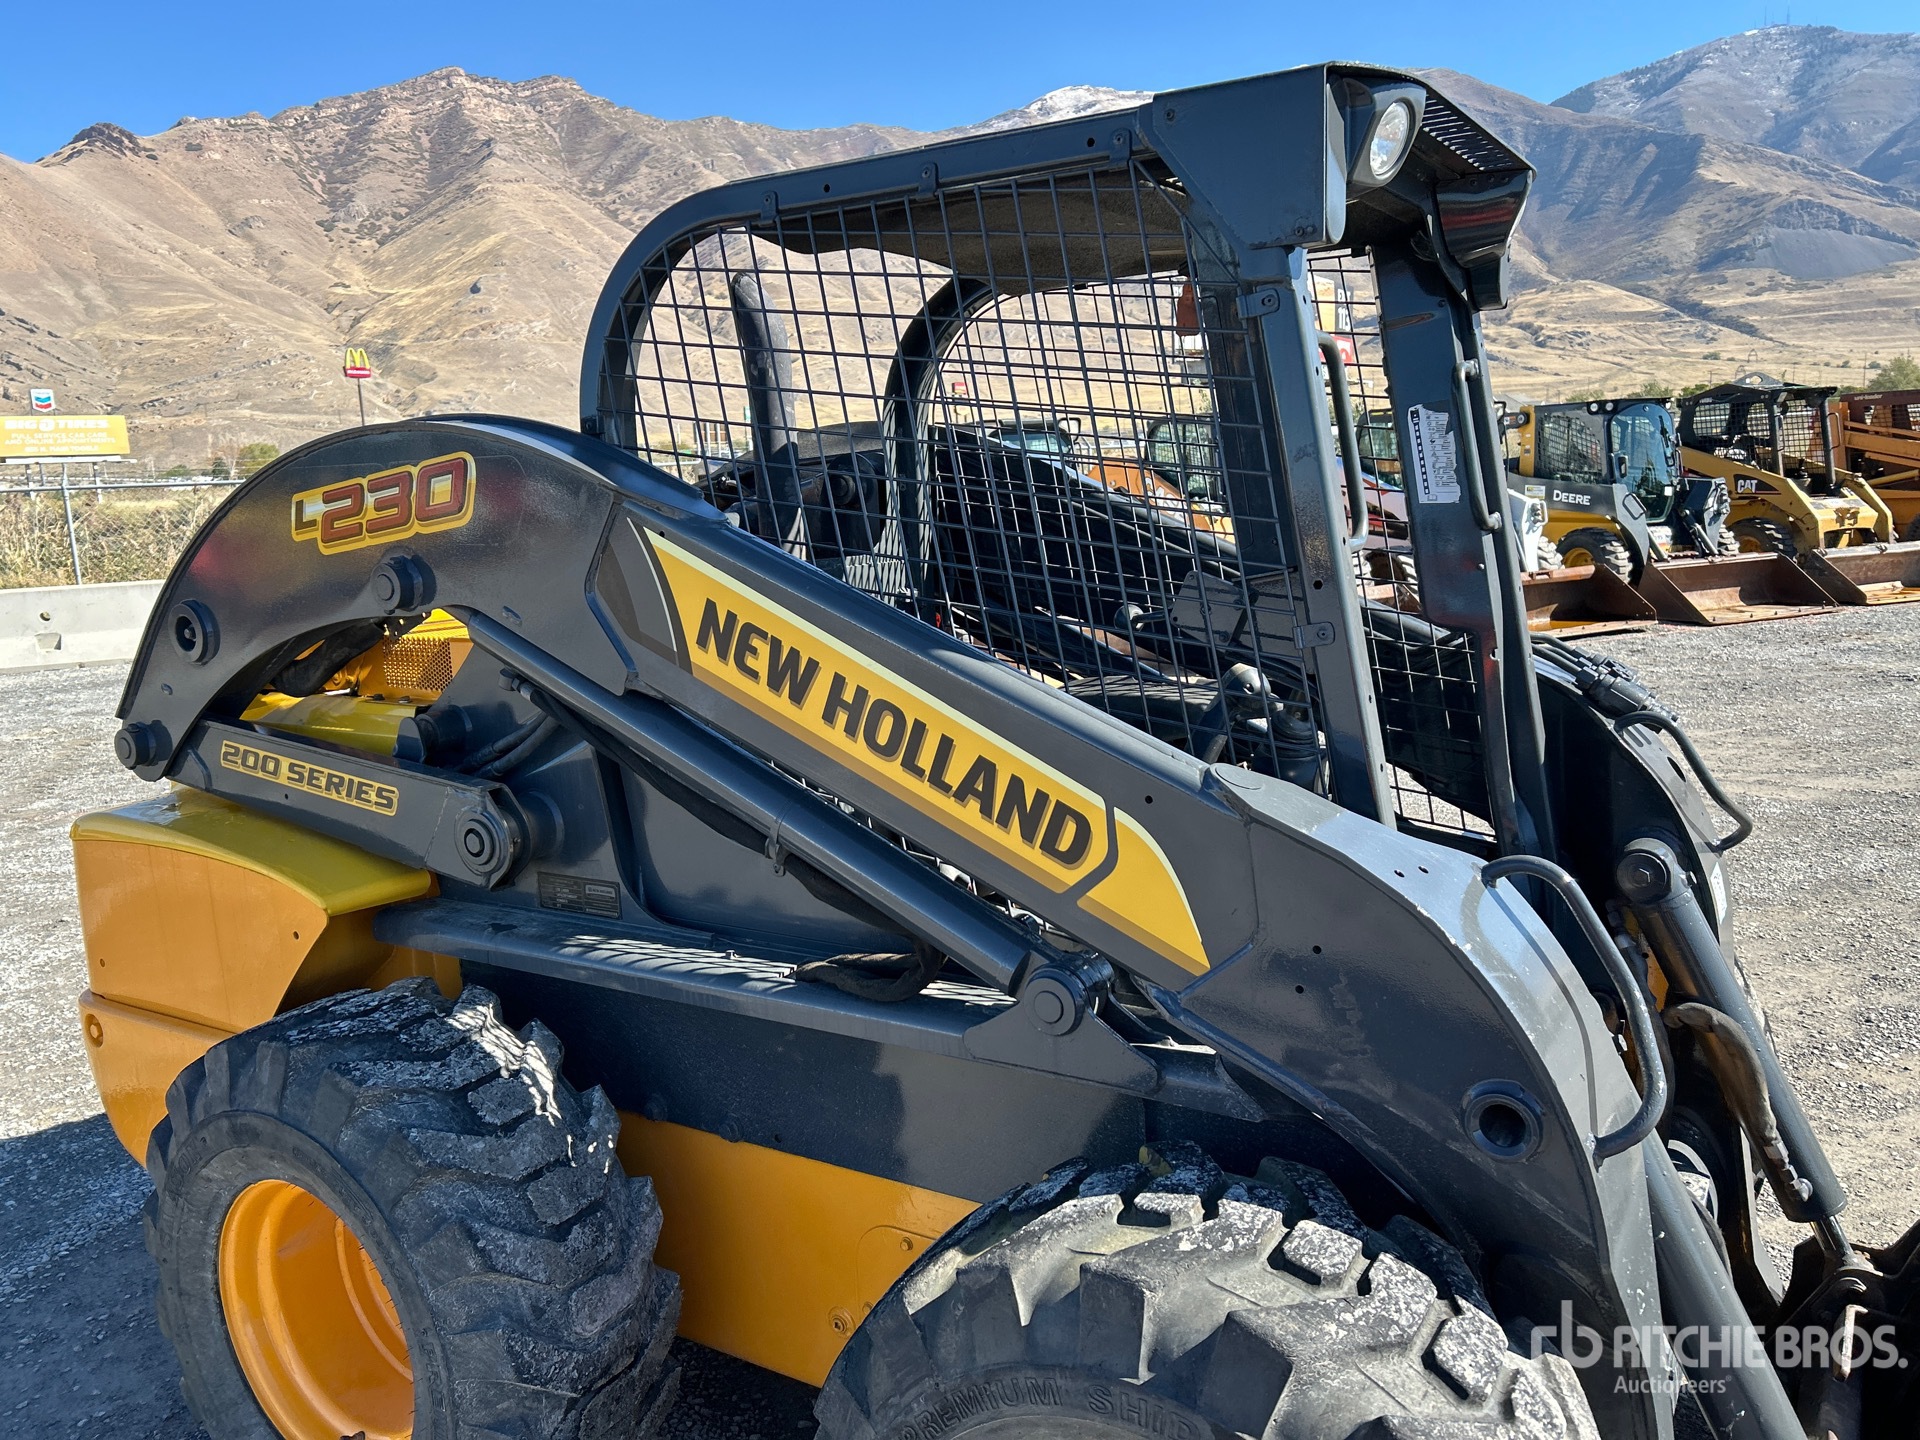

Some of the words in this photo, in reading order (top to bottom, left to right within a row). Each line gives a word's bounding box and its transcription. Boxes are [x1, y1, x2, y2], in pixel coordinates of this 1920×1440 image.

[4, 419, 37, 429] BIG
[57, 419, 108, 429] TIRES
[293, 456, 471, 547] L230
[1553, 489, 1591, 506] DEERE
[1737, 479, 1758, 494] CAT
[695, 597, 820, 709] NEW
[821, 671, 1092, 869] HOLLAND
[222, 743, 282, 778] 200
[287, 761, 397, 811] SERIES
[899, 1376, 1063, 1440] PREMIUM
